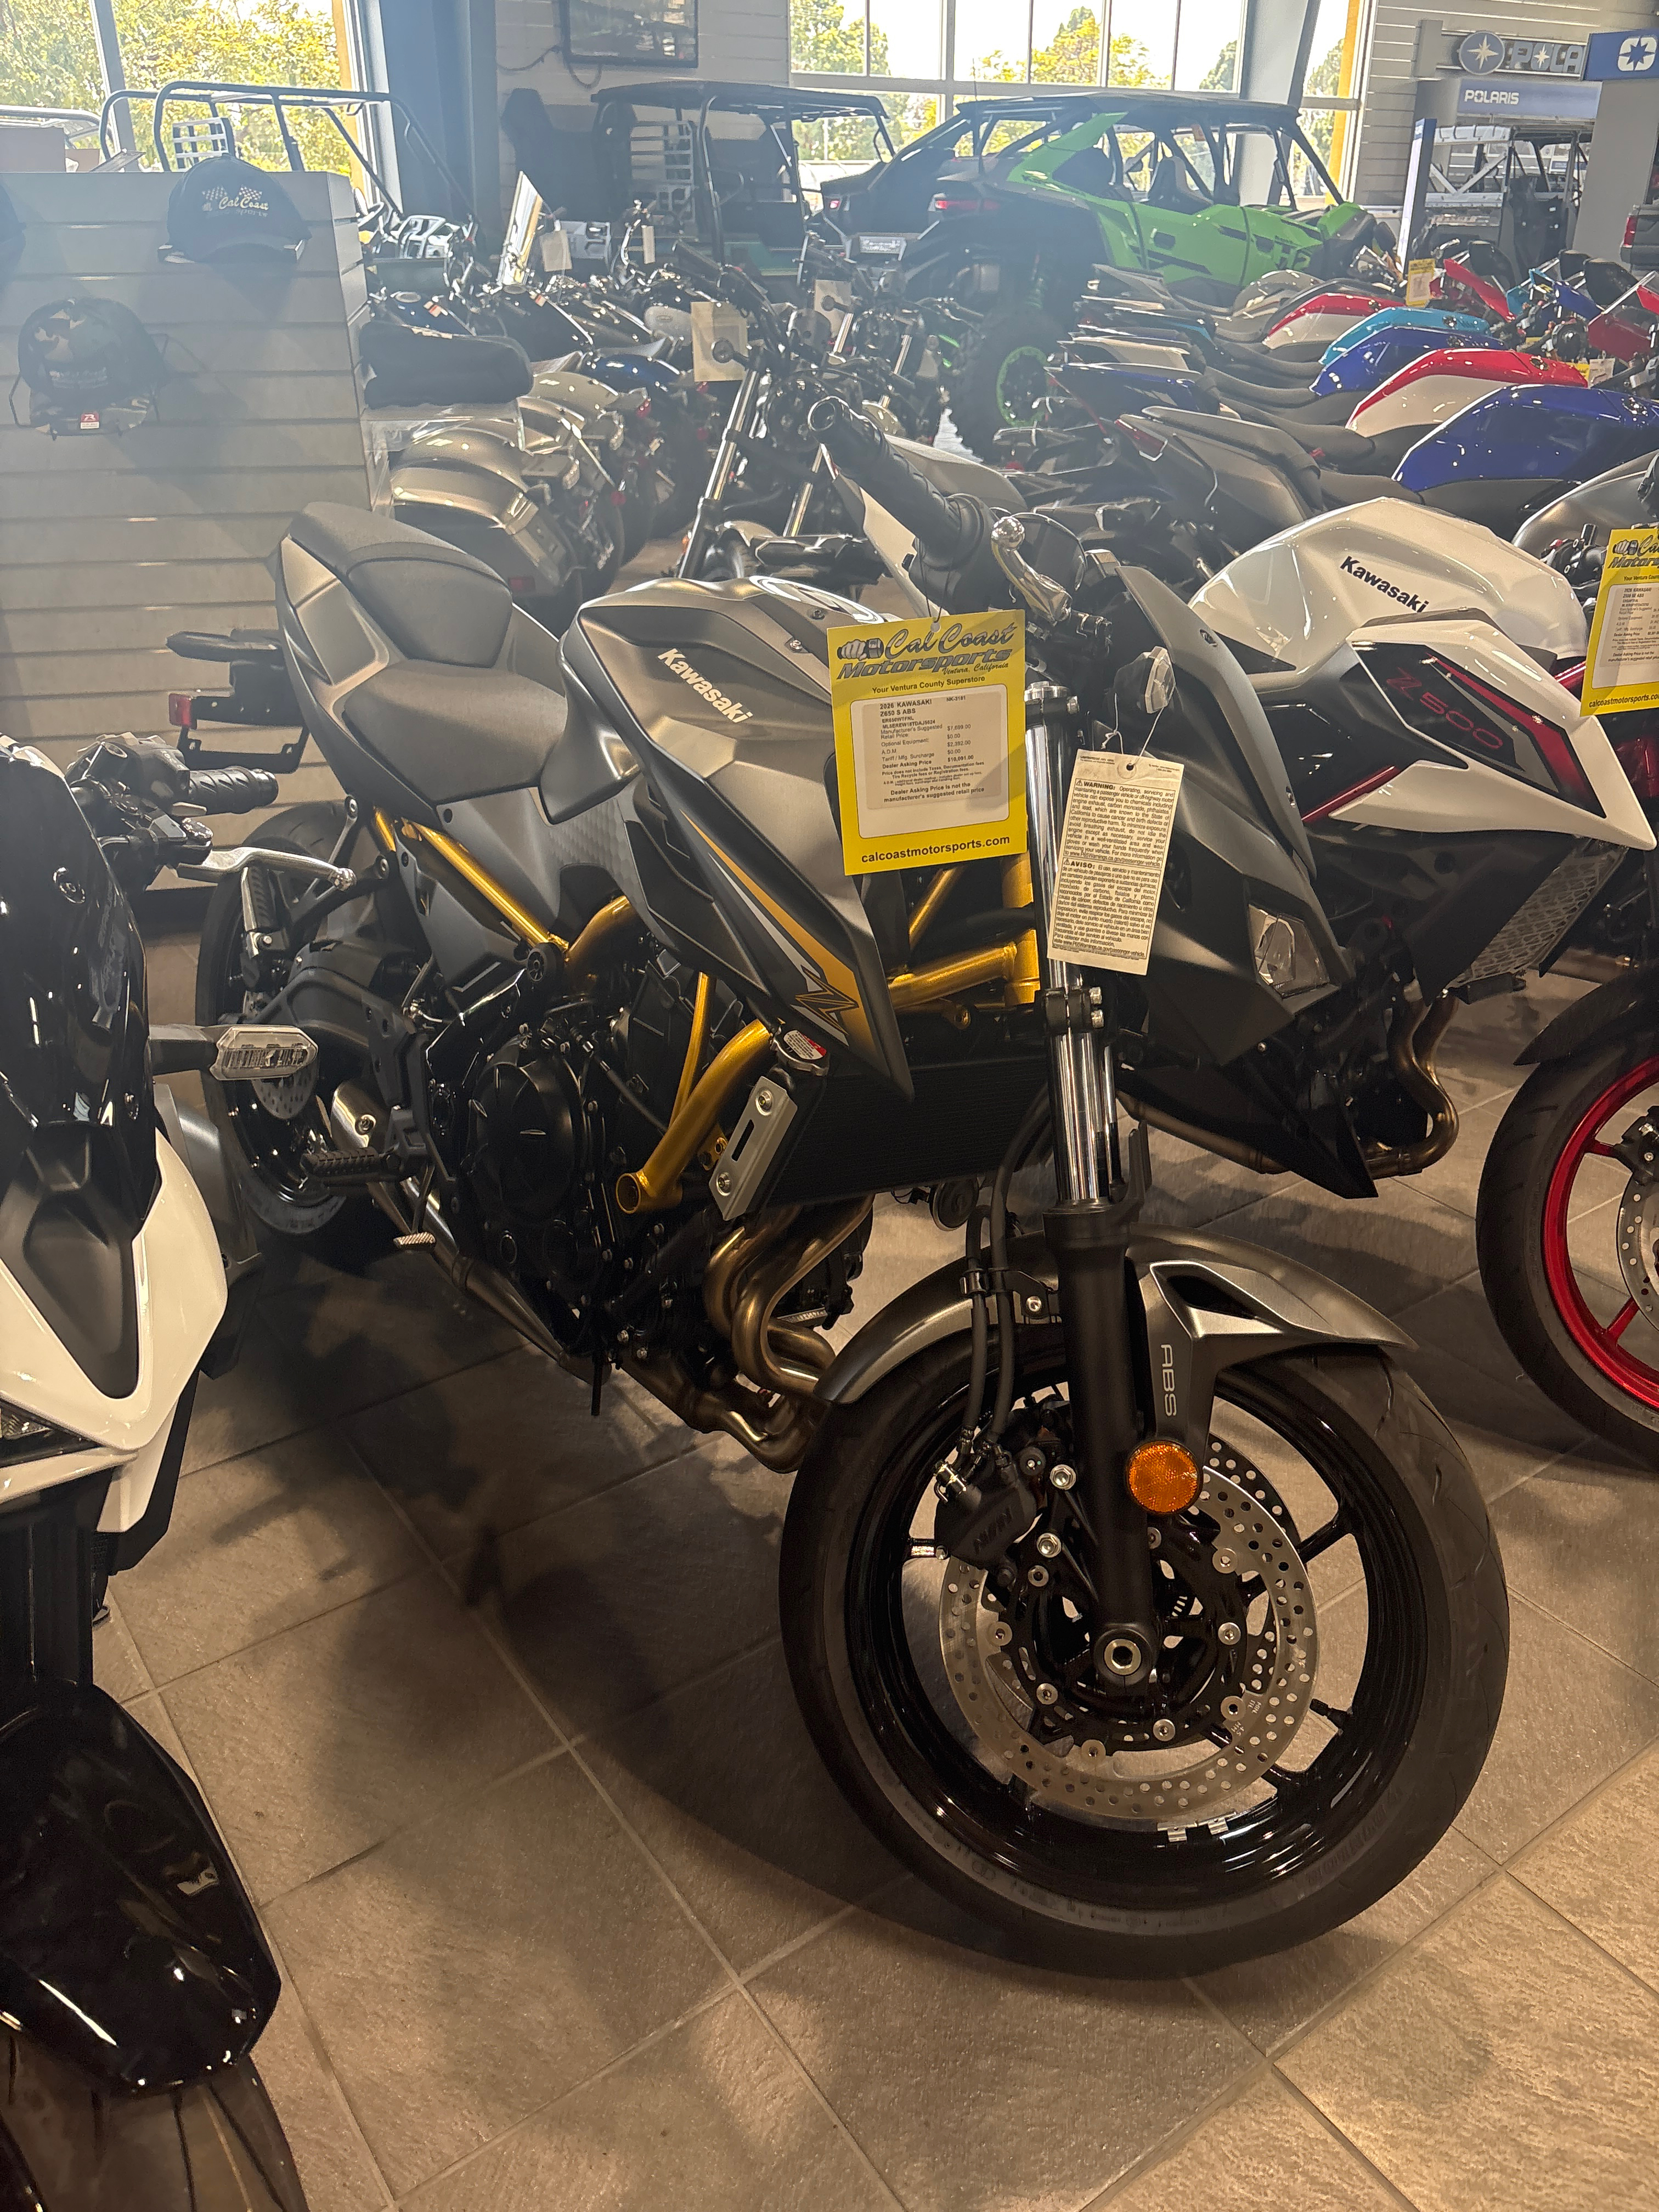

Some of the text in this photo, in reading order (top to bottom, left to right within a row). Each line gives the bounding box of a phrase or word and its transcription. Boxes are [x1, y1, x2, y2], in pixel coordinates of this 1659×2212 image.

[1464, 89, 1519, 105] POLARIS
[219, 196, 269, 211] Cal Coast
[1637, 534, 1659, 556] Ca
[1607, 557, 1659, 568] Motors
[1340, 556, 1429, 613] Kawasaki
[884, 622, 1017, 659] Cal Coast
[836, 648, 1013, 680] Motorsports
[973, 662, 1008, 673] California
[658, 648, 753, 723] Kawasaki
[919, 680, 945, 689] County
[946, 676, 985, 686] Superstore
[897, 699, 932, 708] KAWASAKI
[1386, 667, 1504, 749] Z500
[881, 726, 916, 736] Manufacturer's
[917, 724, 943, 732] Suggested
[1084, 781, 1115, 790] WARNING:
[1119, 786, 1141, 794] Operating,
[884, 794, 925, 803] manufacturer's
[926, 790, 955, 799] suggested
[862, 837, 1009, 862] calcoastmotorsports.com
[1070, 861, 1095, 869] AVISO:
[1161, 1344, 1177, 1416] ABS
